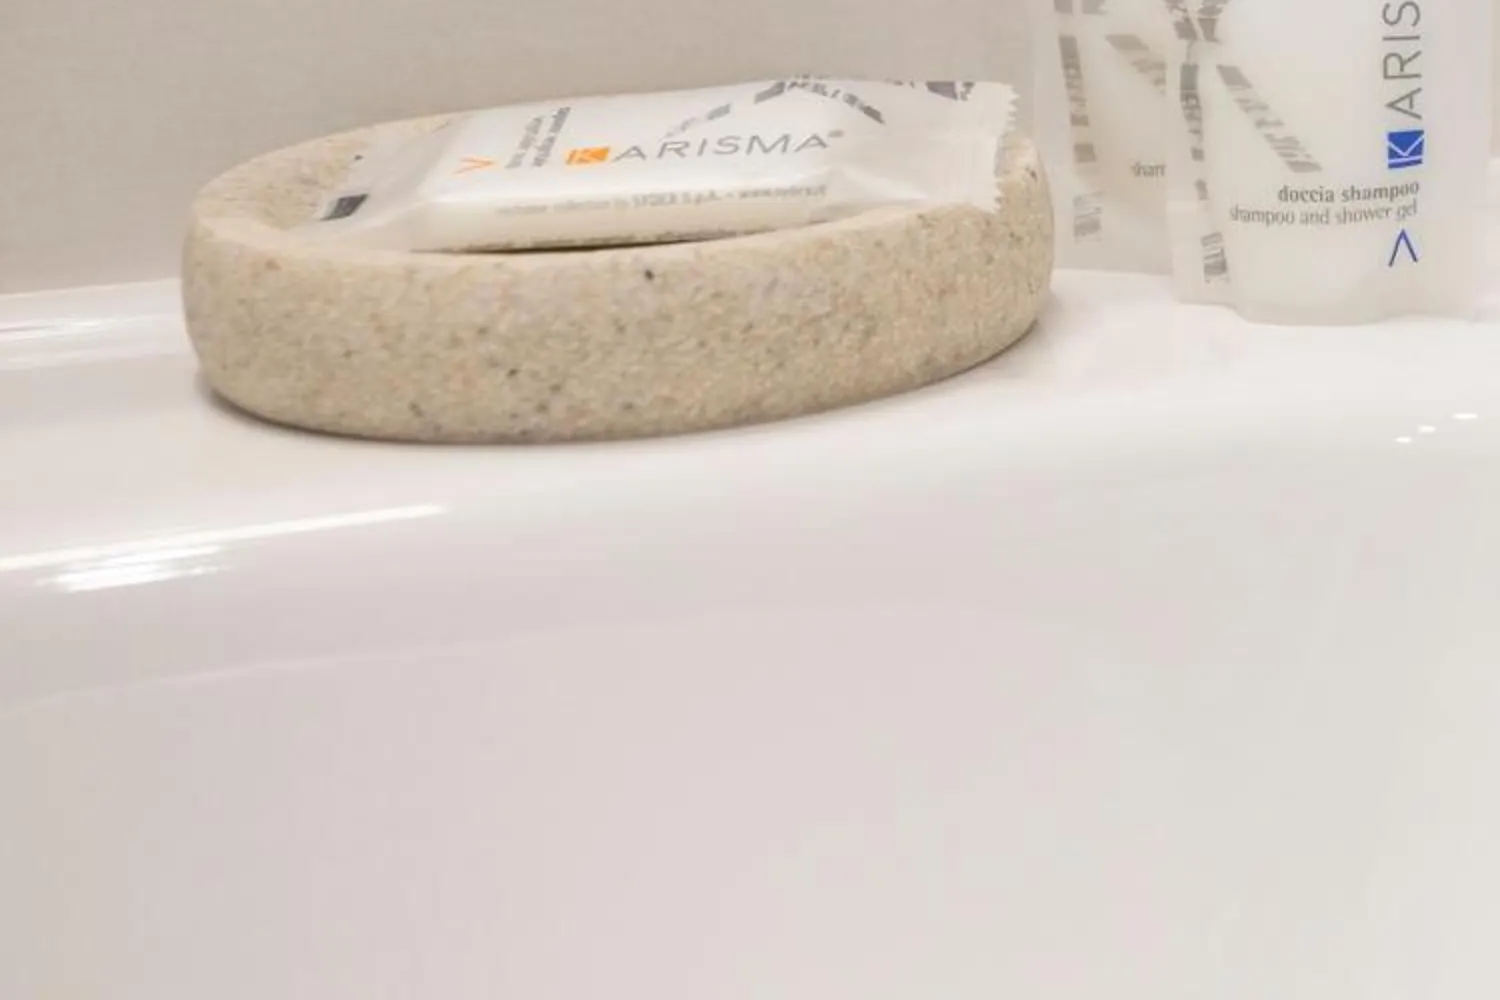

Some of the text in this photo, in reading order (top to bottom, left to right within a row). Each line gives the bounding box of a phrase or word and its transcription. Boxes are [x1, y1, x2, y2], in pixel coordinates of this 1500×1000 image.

[1277, 179, 1421, 205] doccia shampoo
[1229, 198, 1418, 228] shampoo and shower gel
